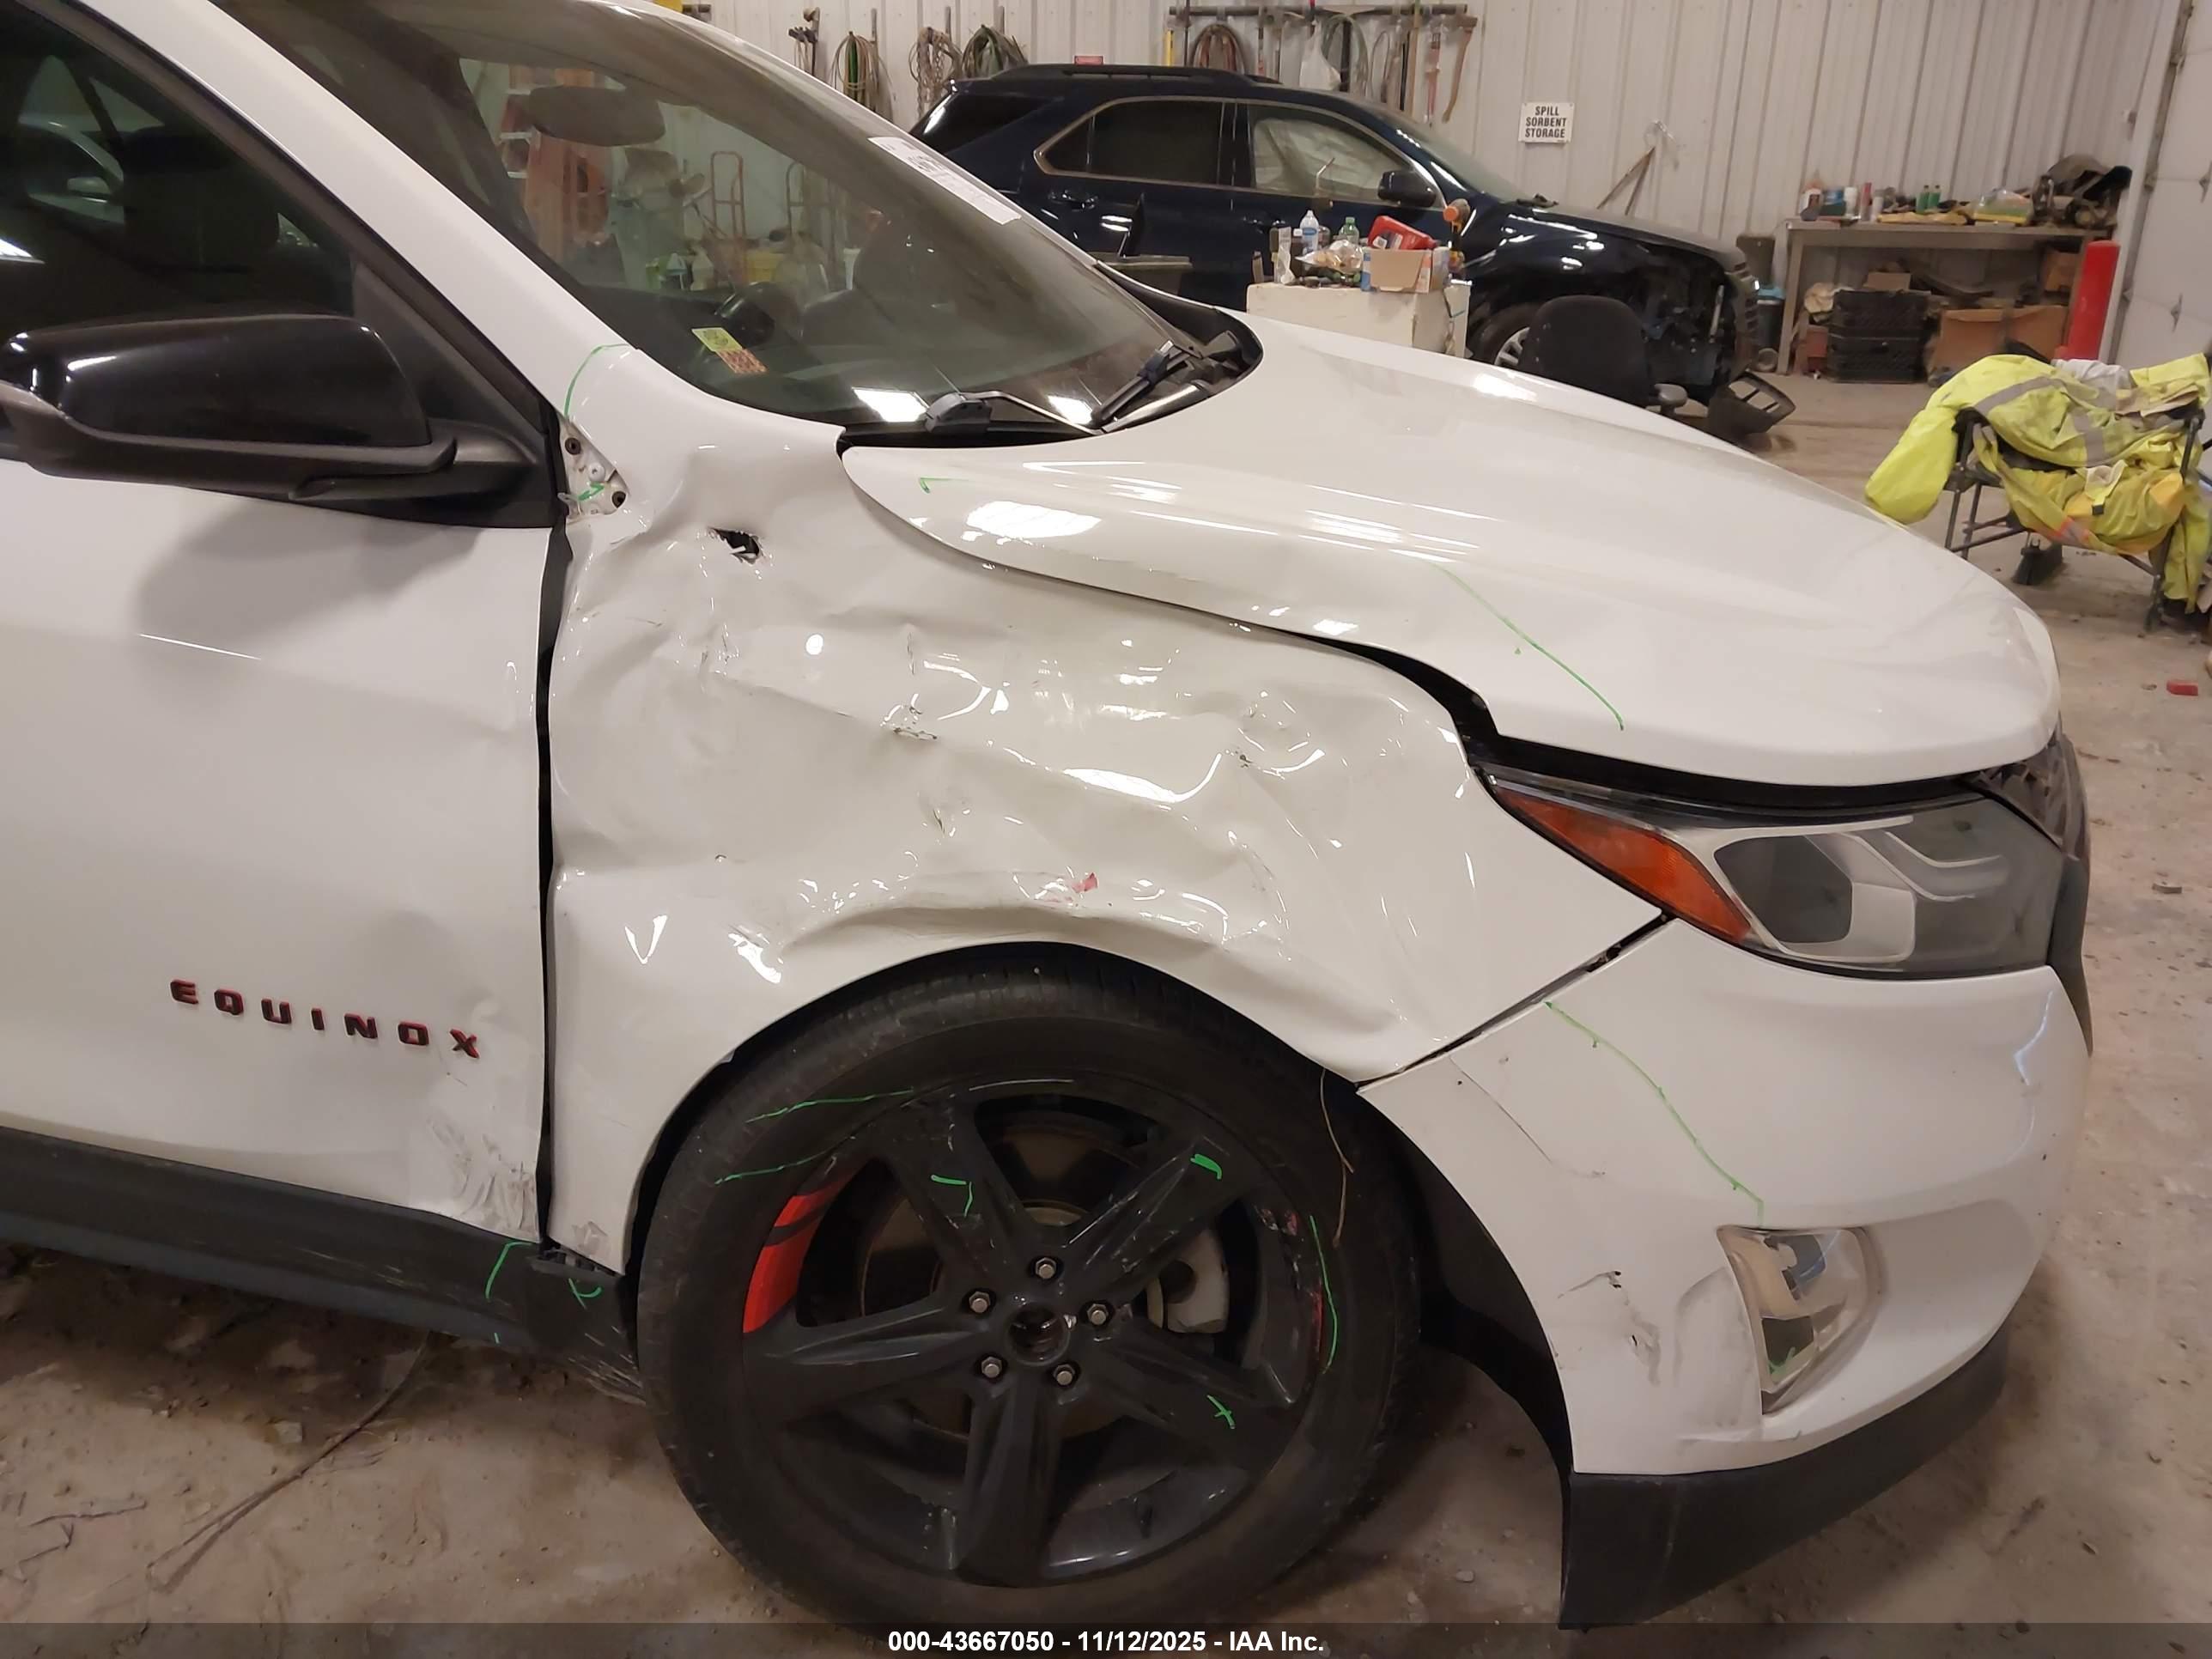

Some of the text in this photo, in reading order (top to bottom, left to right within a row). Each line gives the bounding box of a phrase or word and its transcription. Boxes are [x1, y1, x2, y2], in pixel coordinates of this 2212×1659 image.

[1534, 106, 1559, 116] SPILL
[1525, 117, 1567, 127] SORBENT
[1524, 128, 1565, 138] STORAGE
[169, 978, 480, 1060] EQUINOX
